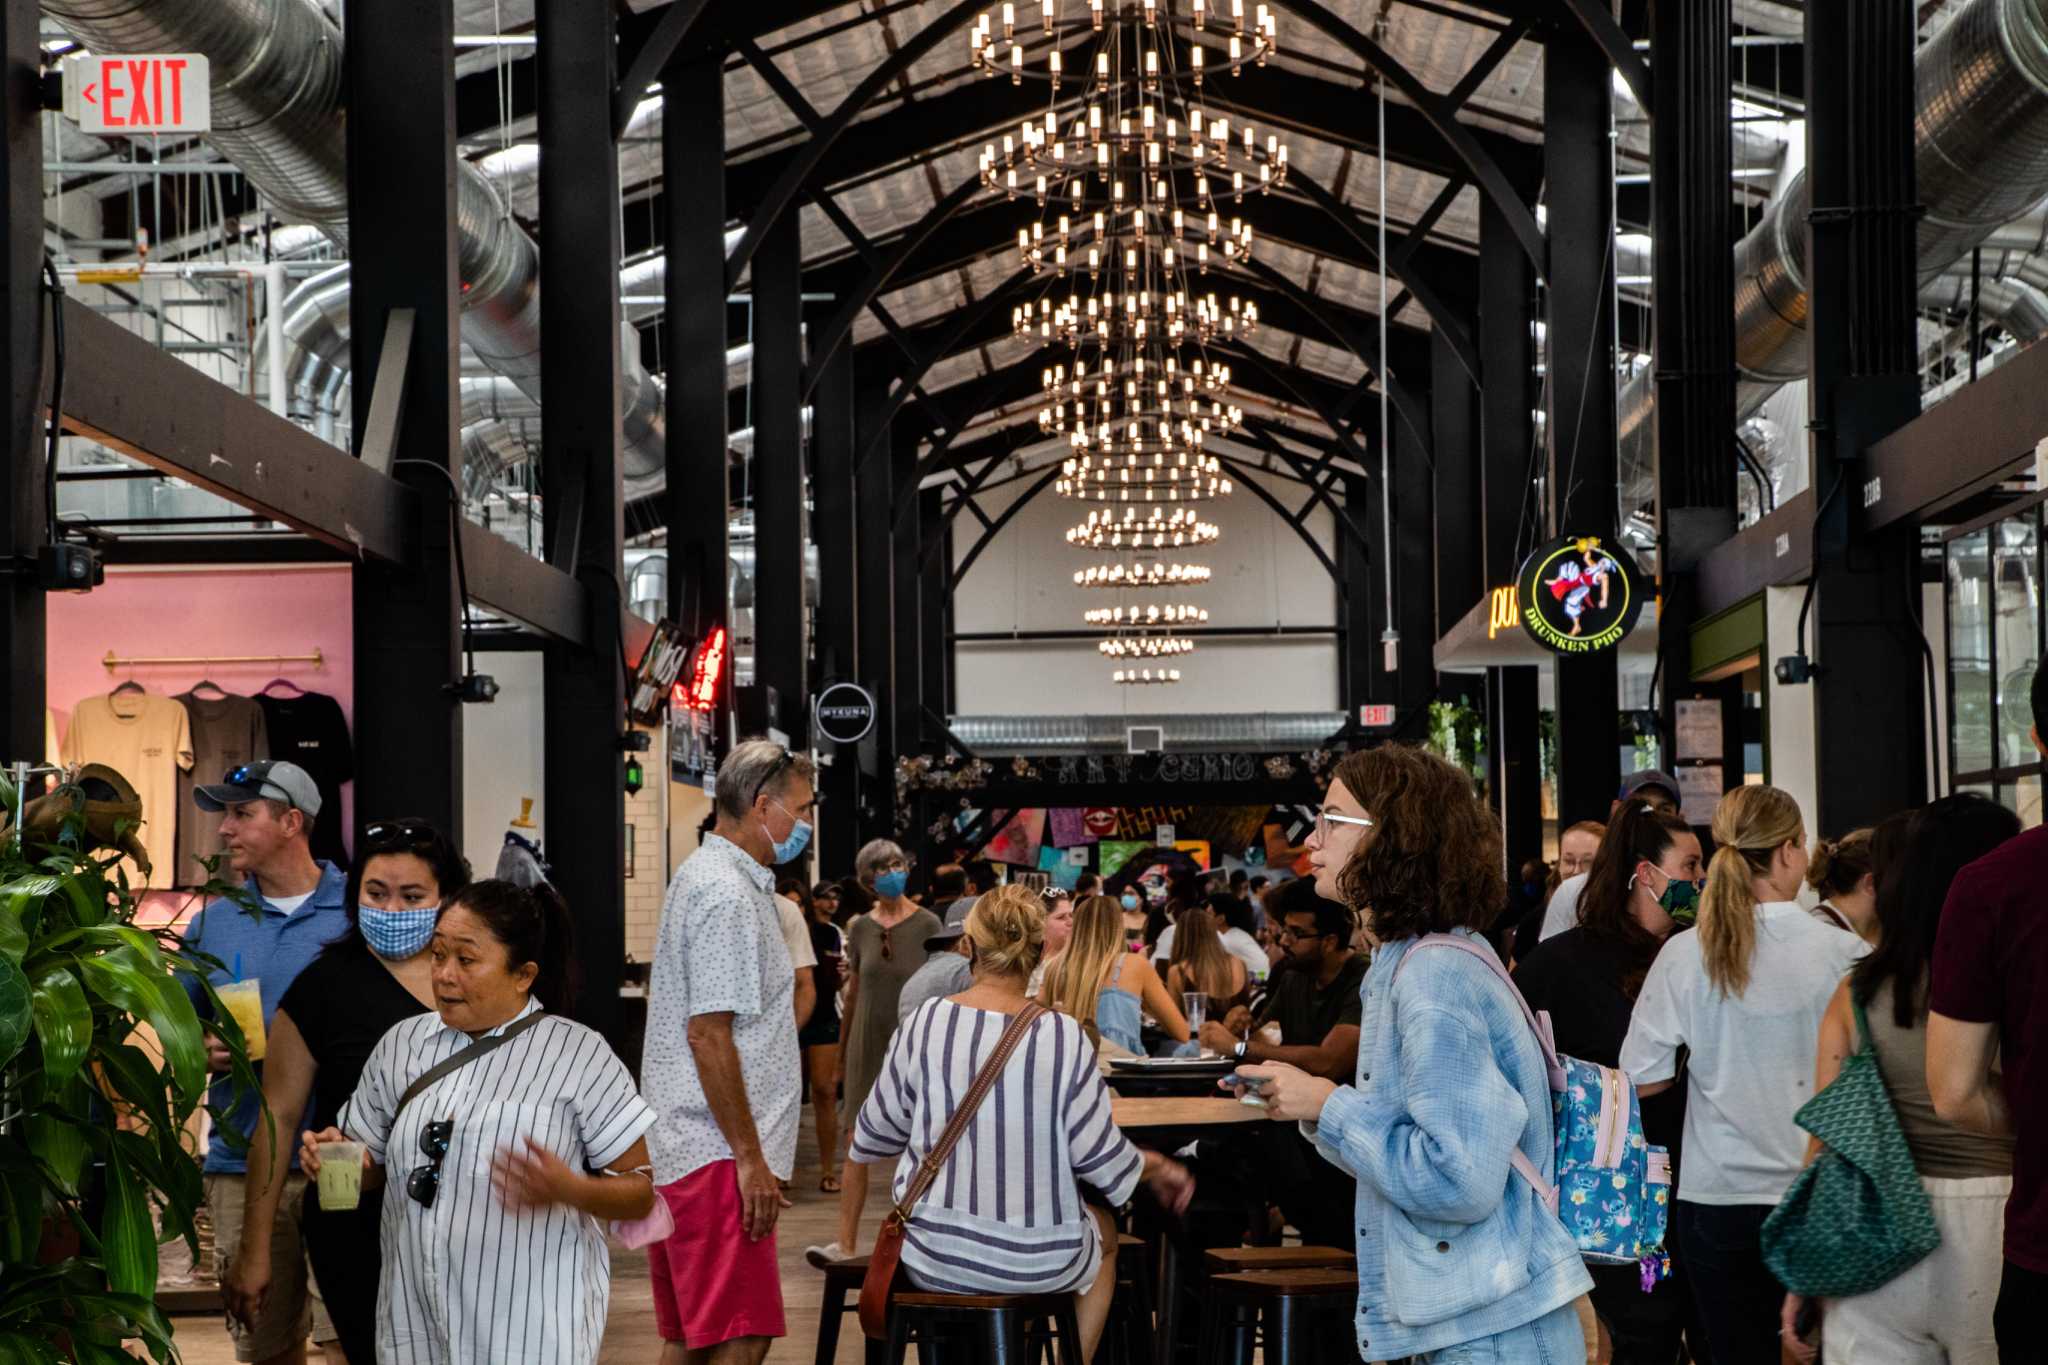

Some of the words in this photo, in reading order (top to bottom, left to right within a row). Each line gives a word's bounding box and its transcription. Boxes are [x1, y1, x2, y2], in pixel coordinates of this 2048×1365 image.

[101, 59, 188, 126] EXIT
[1524, 606, 1590, 653] DRUNKEN
[1593, 625, 1624, 651] PHO
[1365, 706, 1390, 722] EXIT
[1158, 753, 1255, 783] CURIO
